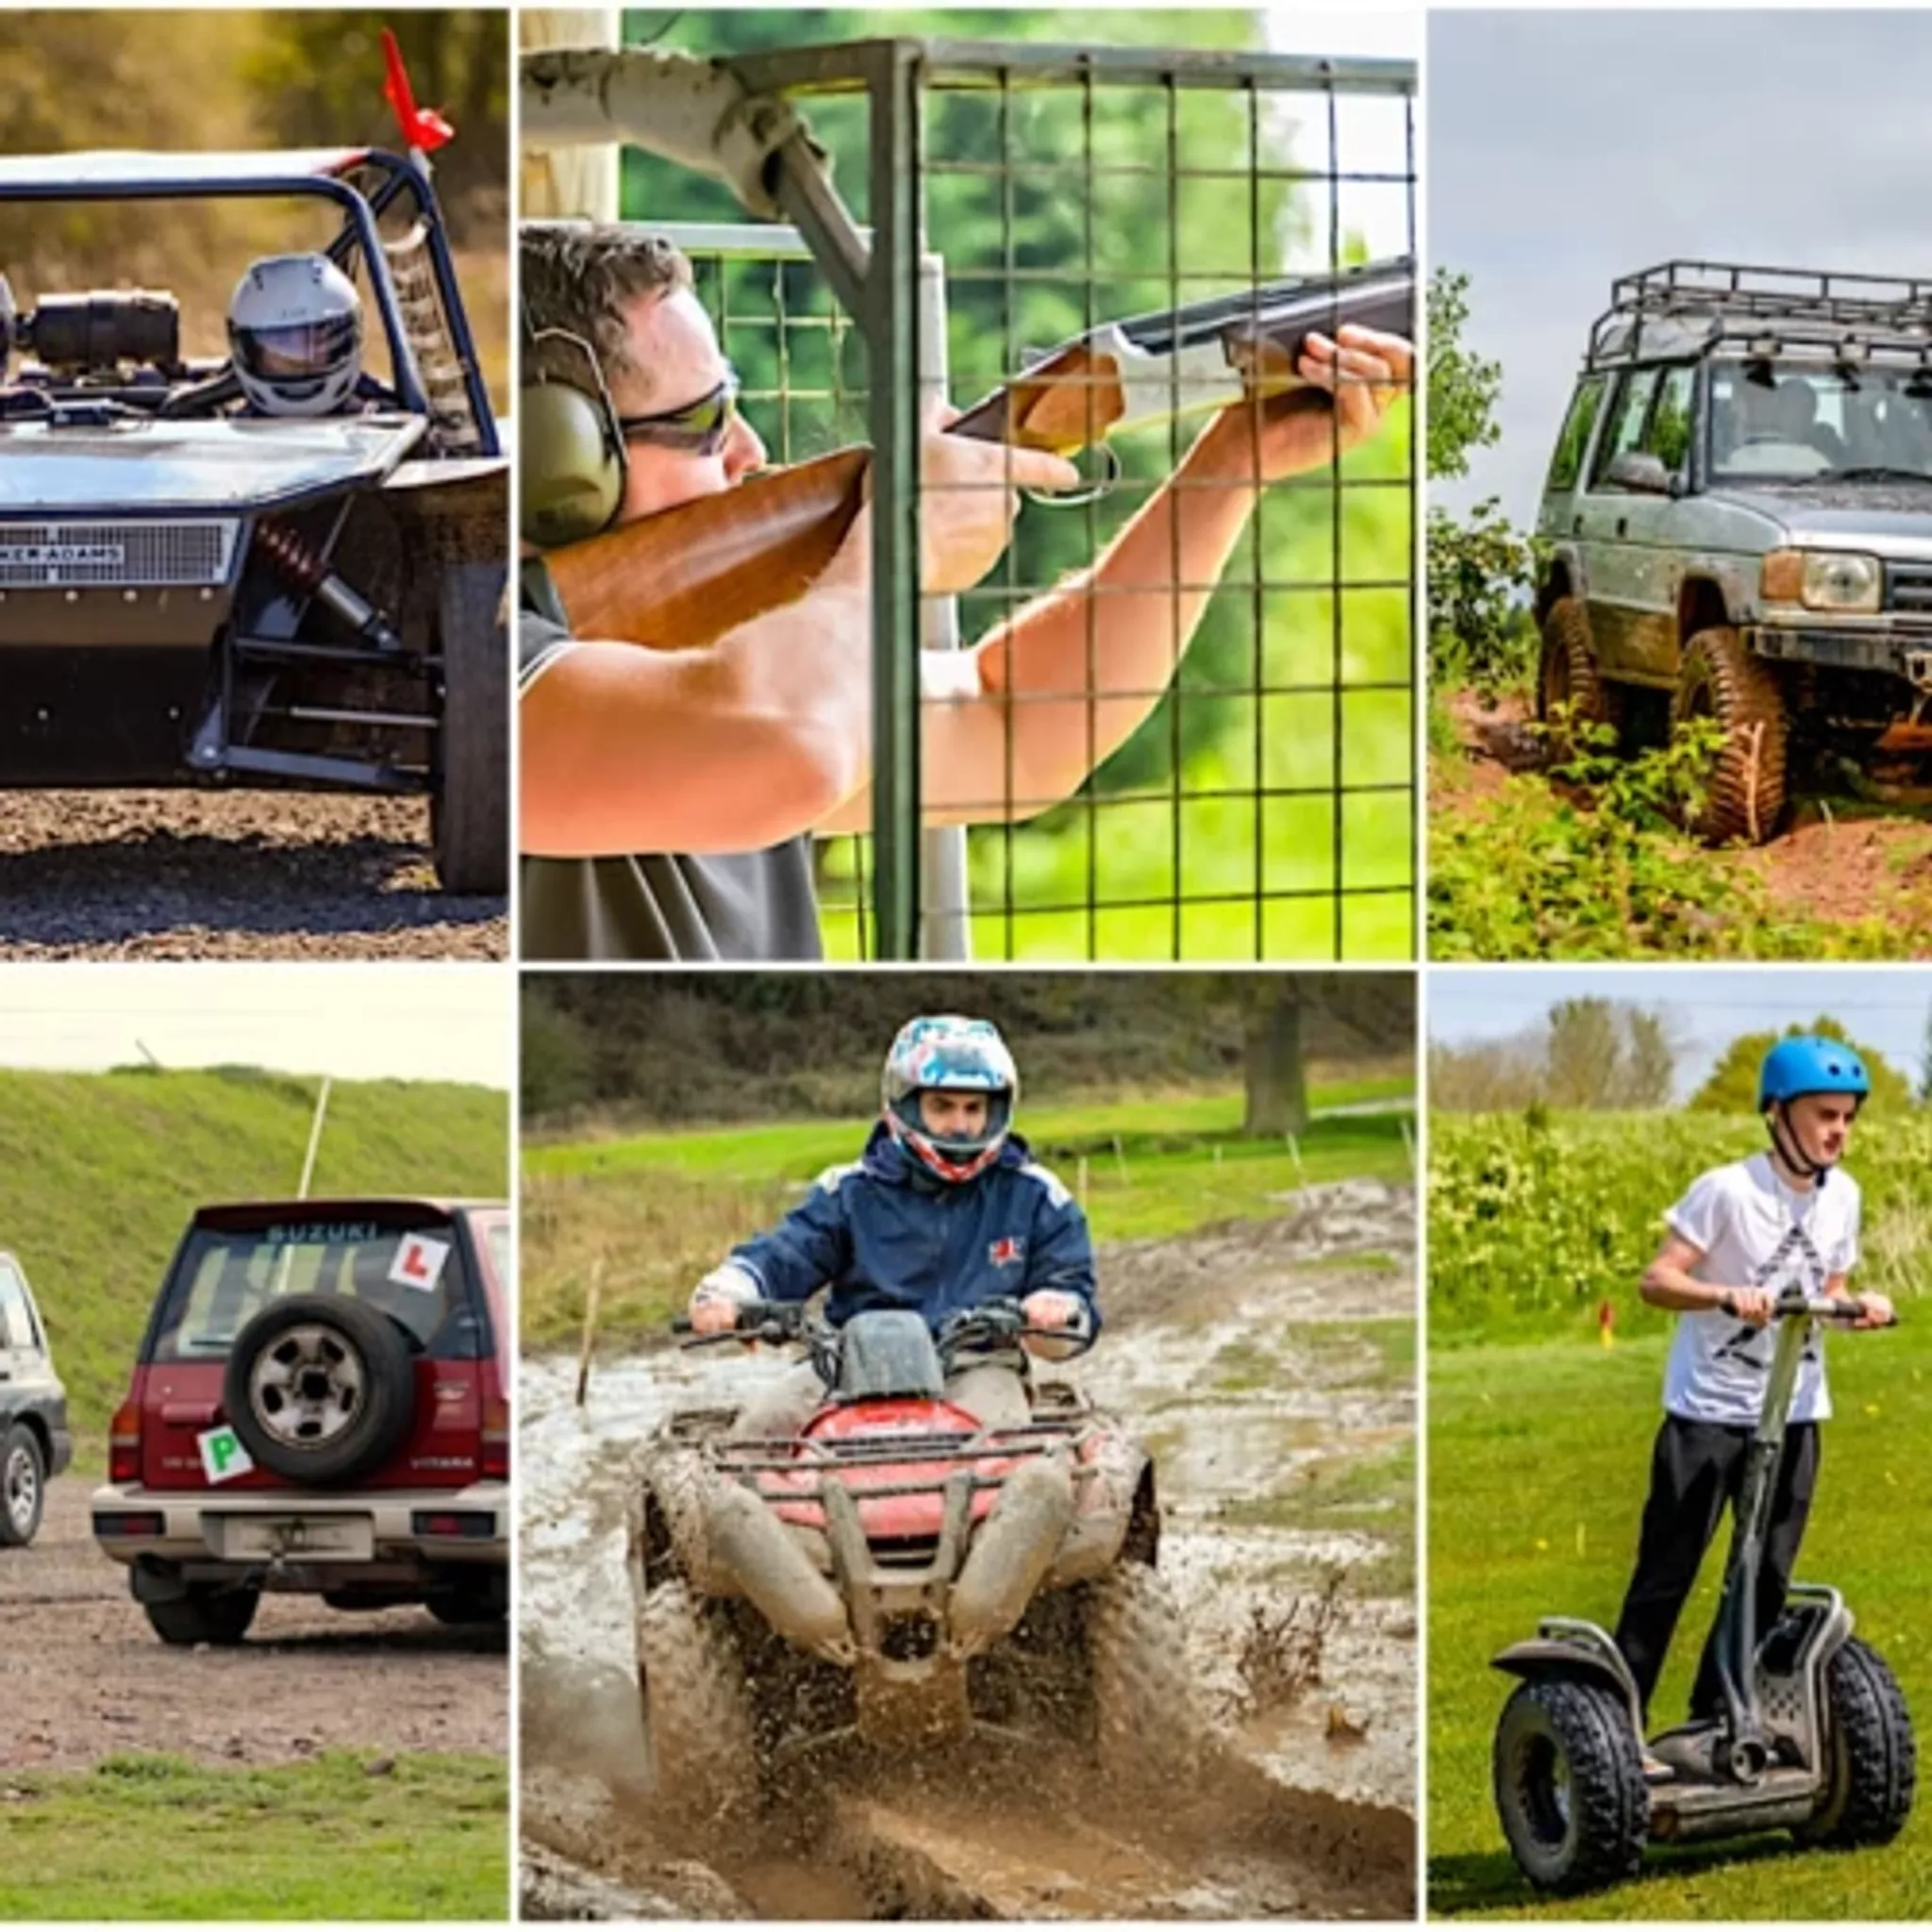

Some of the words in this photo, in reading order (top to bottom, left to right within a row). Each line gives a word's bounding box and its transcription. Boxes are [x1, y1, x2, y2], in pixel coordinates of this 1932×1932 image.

[267, 1222, 377, 1242] SUZUKI
[402, 1243, 429, 1280] L
[208, 1433, 237, 1473] P
